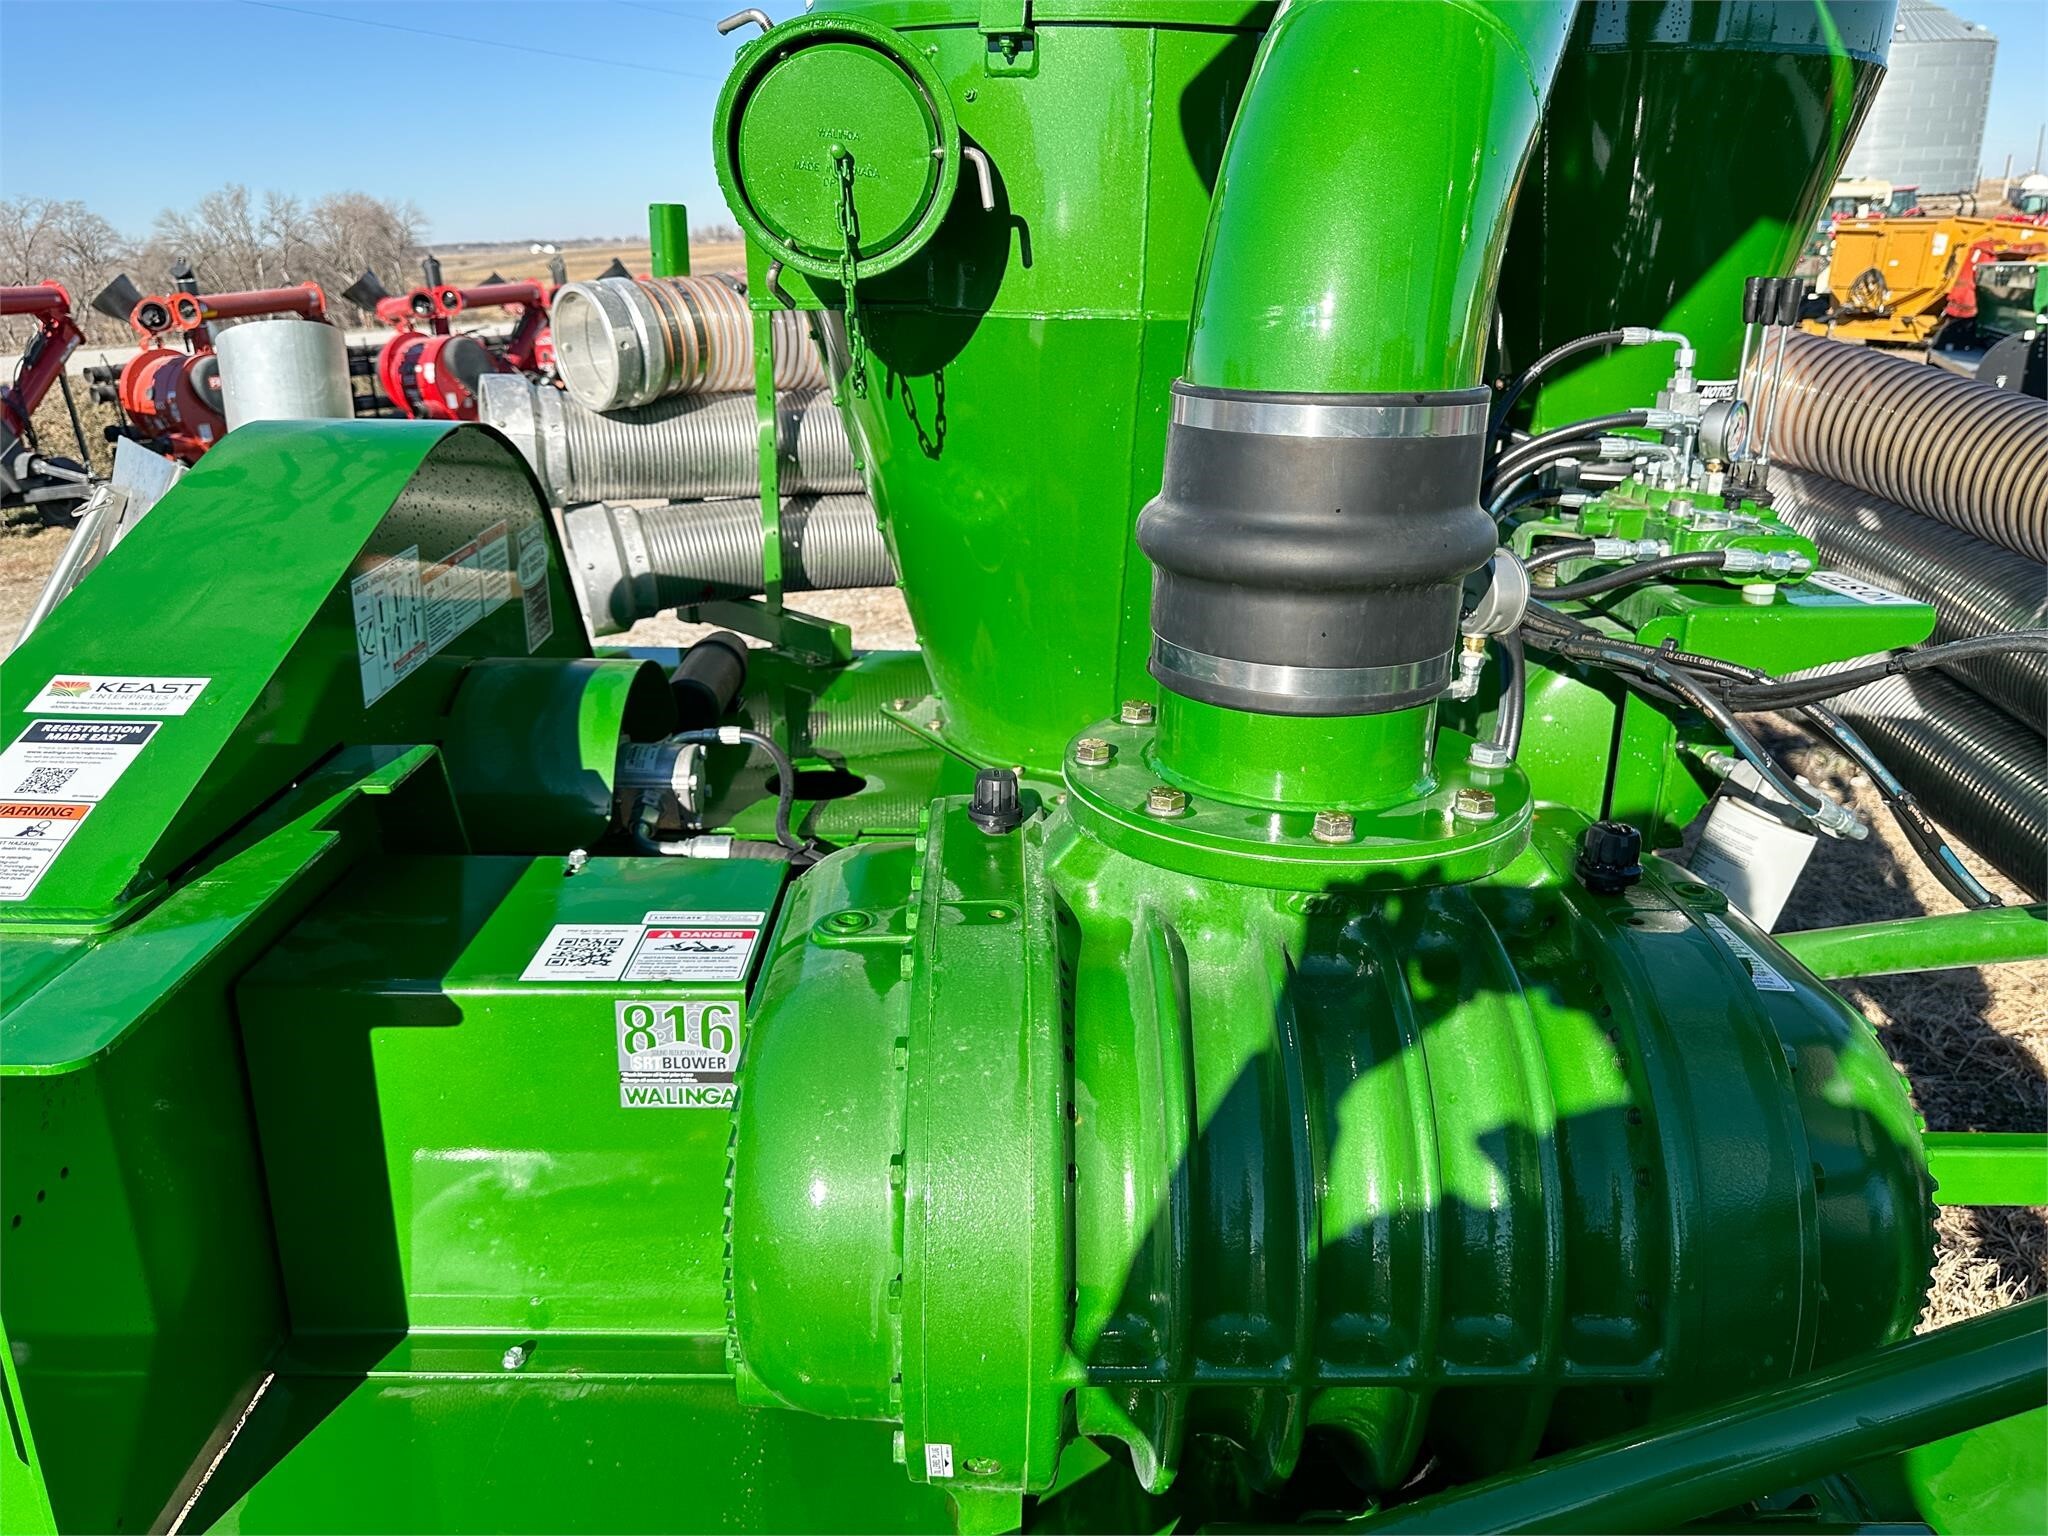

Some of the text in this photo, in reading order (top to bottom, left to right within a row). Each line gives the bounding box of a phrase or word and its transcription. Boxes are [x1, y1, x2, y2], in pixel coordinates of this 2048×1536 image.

[816, 128, 860, 141] WALINGA
[794, 160, 820, 172] MADE
[855, 166, 880, 179] NADA
[1700, 385, 1735, 398] NOTICE
[1673, 654, 1698, 664] 11237
[1699, 658, 1713, 667] ISO
[95, 682, 202, 694] KEAST
[89, 693, 170, 701] ENTERPRISES
[41, 724, 145, 734] REGISTRATION
[45, 733, 127, 742] MADE EASY
[0, 806, 75, 817] ARNING
[623, 1005, 733, 1055] 816
[662, 1056, 726, 1069] BLOWER
[624, 1087, 735, 1105] WALINGA
